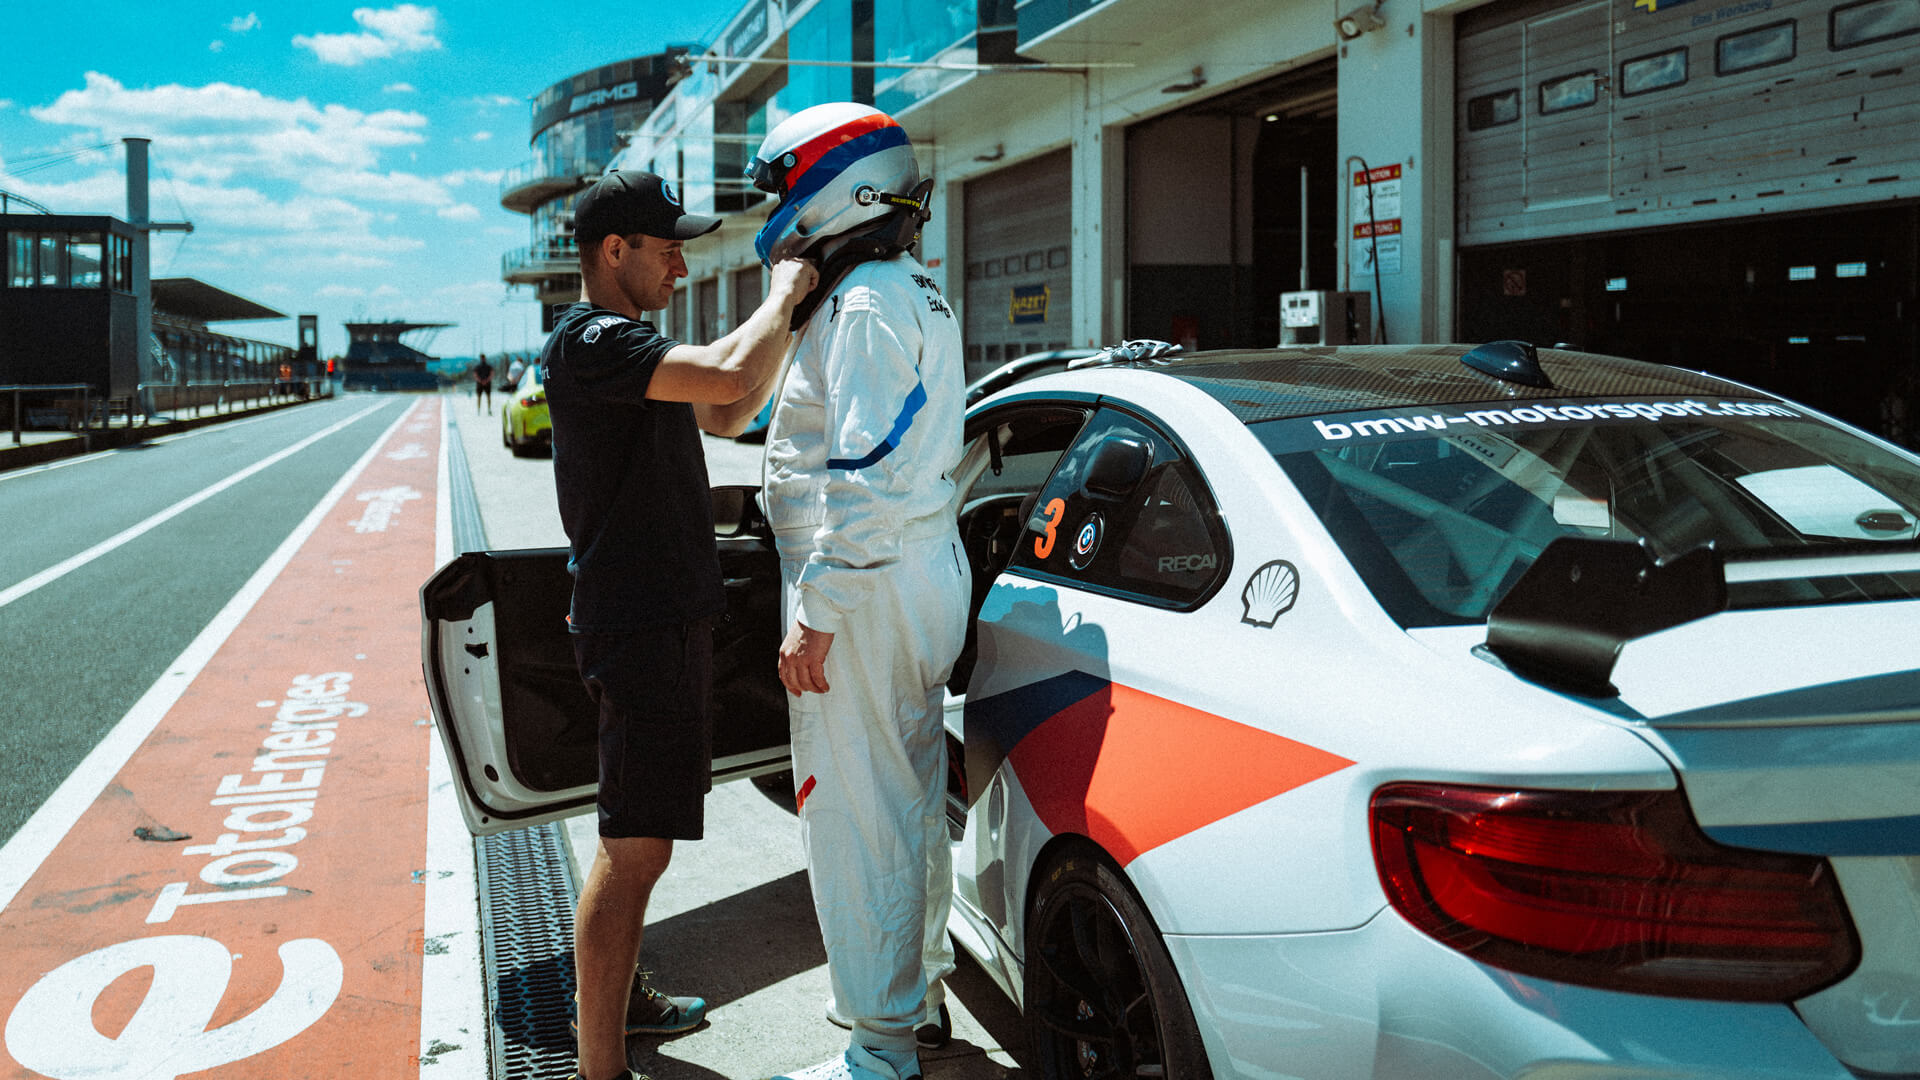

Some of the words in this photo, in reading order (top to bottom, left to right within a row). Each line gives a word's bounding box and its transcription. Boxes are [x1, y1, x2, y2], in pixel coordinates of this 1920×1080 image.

[586, 81, 638, 107] AMG
[1363, 170, 1391, 181] CUTION
[1361, 223, 1394, 235] ACTUNG
[1313, 400, 1800, 442] bmw-motorsport.com
[1034, 498, 1065, 559] 3
[145, 672, 369, 924] TotalEnergies
